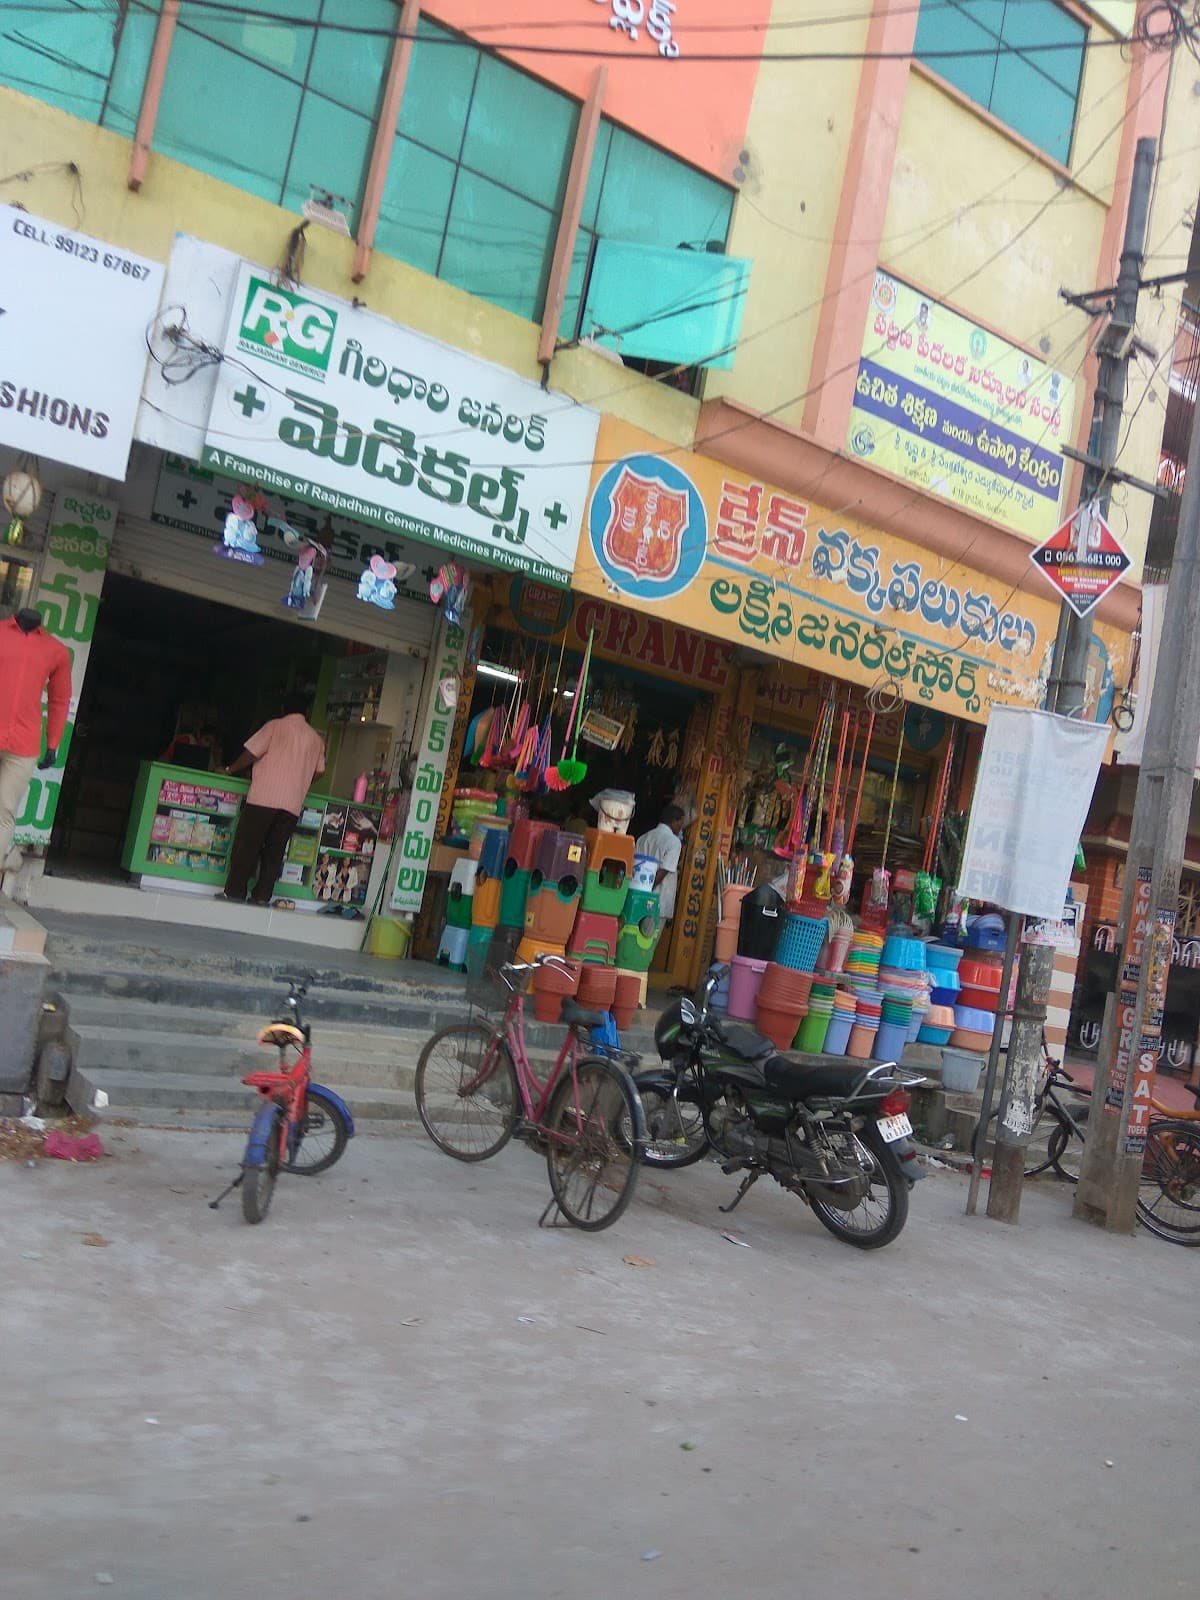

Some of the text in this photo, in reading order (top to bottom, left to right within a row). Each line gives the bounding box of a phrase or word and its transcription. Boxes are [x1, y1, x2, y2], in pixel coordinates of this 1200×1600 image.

[54, 234, 99, 264] 99123
[103, 251, 151, 282] 67867
[0, 380, 111, 440] SHIONS
[338, 338, 548, 452] గిరిధారి జనరిక్
[857, 370, 898, 408] ఉచిత
[900, 391, 938, 433] శిక్షణ
[976, 428, 1018, 469] ఉపాధి
[1018, 447, 1060, 489] కేంద్రం
[278, 387, 531, 546] మెడికల్స్
[208, 452, 221, 465] A
[223, 454, 292, 490] Franchise
[294, 478, 309, 495] of
[311, 483, 383, 522] Raajadhani
[384, 509, 431, 540] Generic
[433, 526, 491, 557] Medicines
[492, 548, 531, 574] Private
[712, 480, 809, 568] క్రేన్
[1105, 555, 1122, 567] 000
[575, 600, 734, 688] CRANE
[1132, 1053, 1155, 1124] SAT
